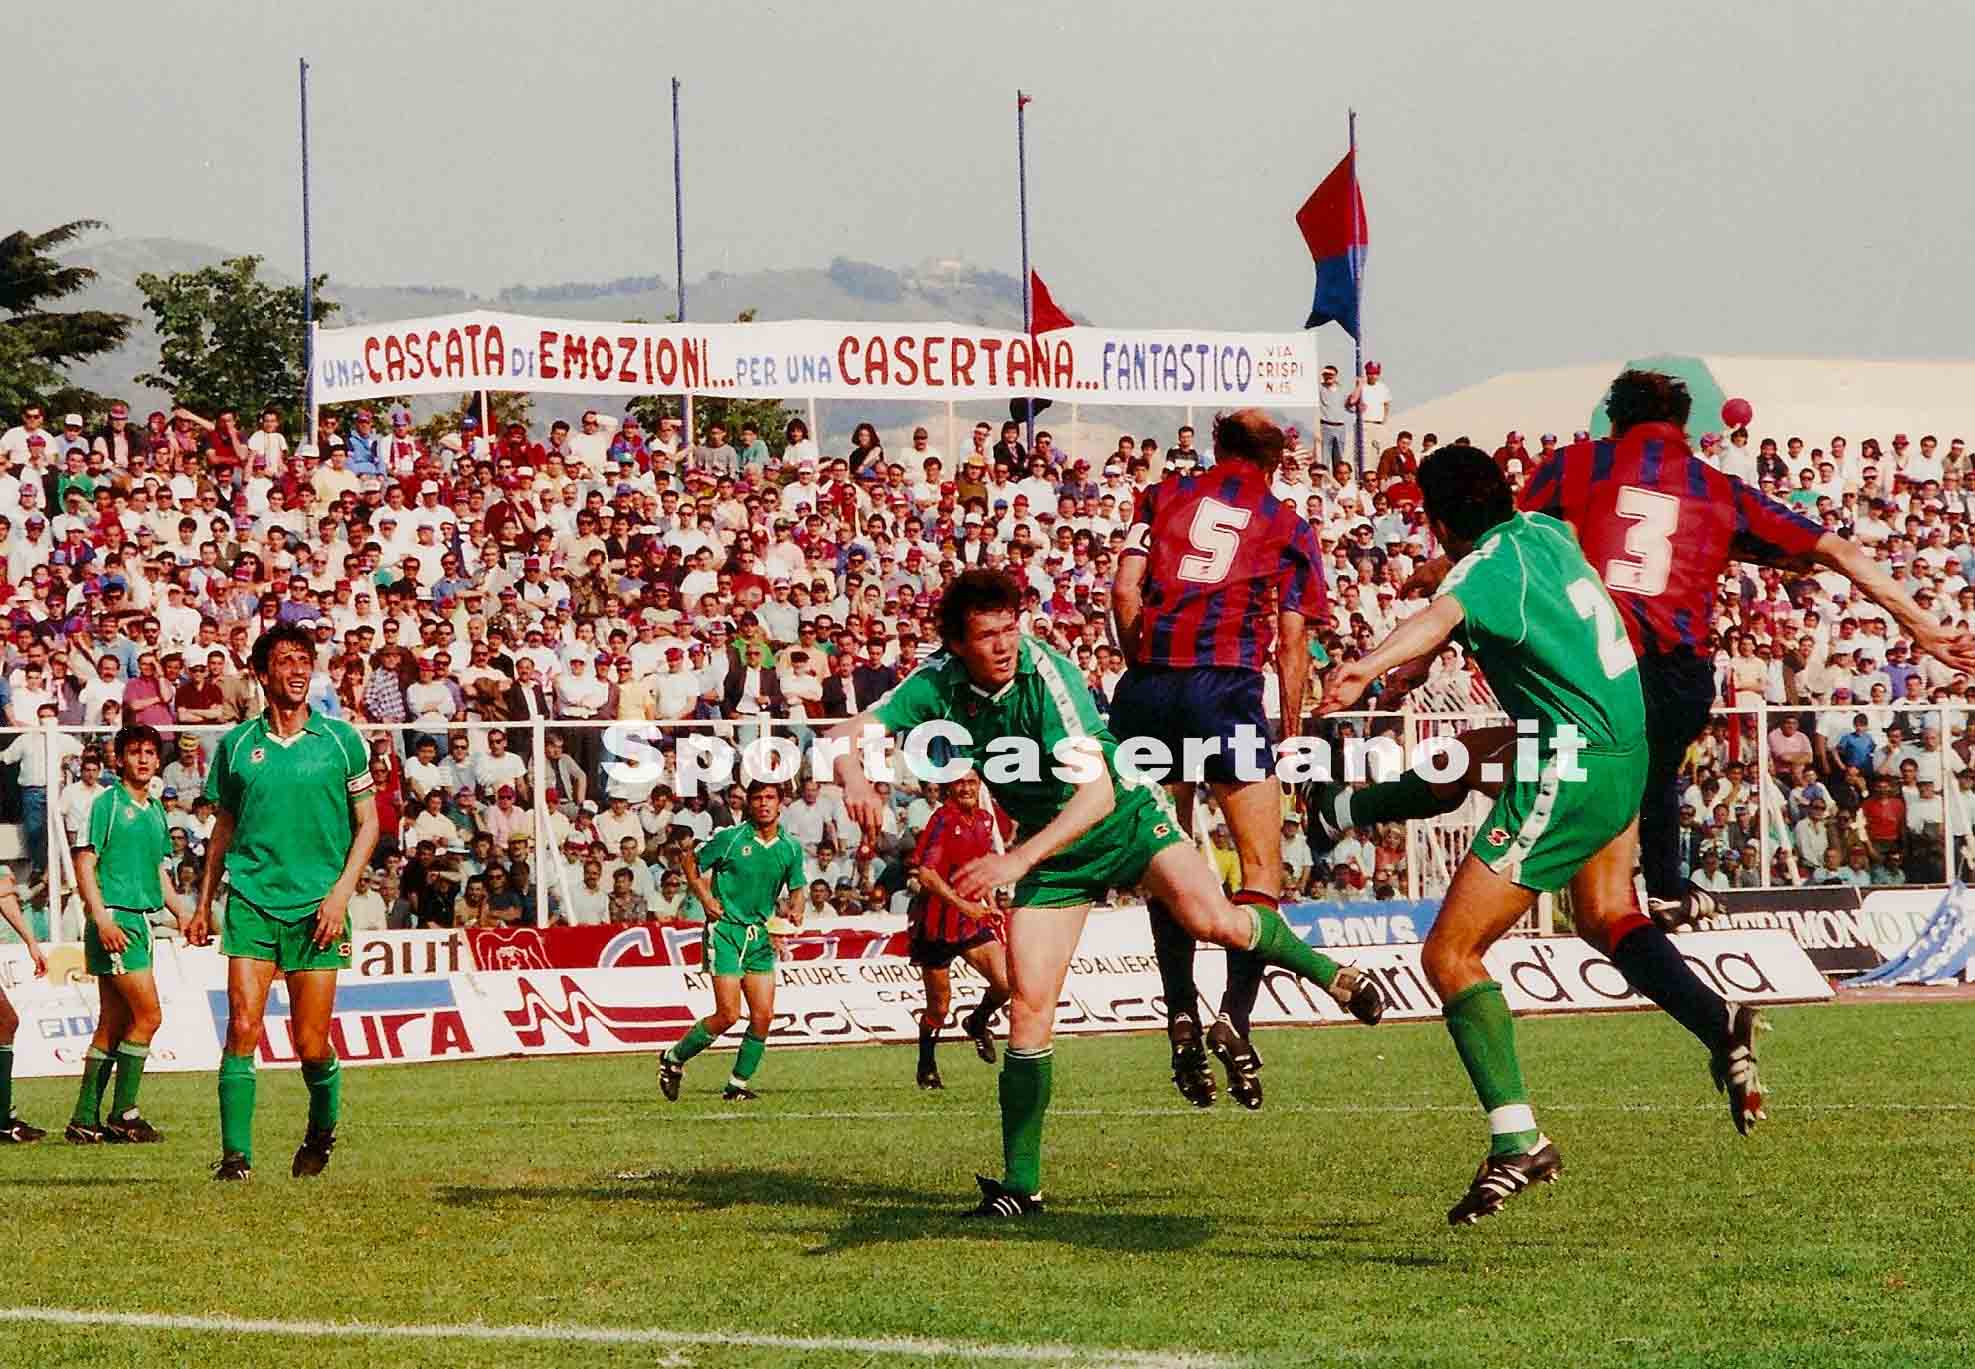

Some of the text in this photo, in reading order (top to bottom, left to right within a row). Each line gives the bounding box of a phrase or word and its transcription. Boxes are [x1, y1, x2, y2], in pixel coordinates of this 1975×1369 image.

[323, 358, 365, 388] UNA
[364, 324, 505, 384] CASCATA
[512, 346, 535, 377] DI
[736, 357, 778, 386] PER
[788, 356, 832, 384] UNA
[1104, 342, 1252, 392] FANTASTICO
[1256, 361, 1304, 378] CRISPI
[1264, 345, 1293, 357] VIA
[1179, 496, 1252, 583] 5
[1605, 486, 1680, 596] 3
[1566, 577, 1638, 679] 2
